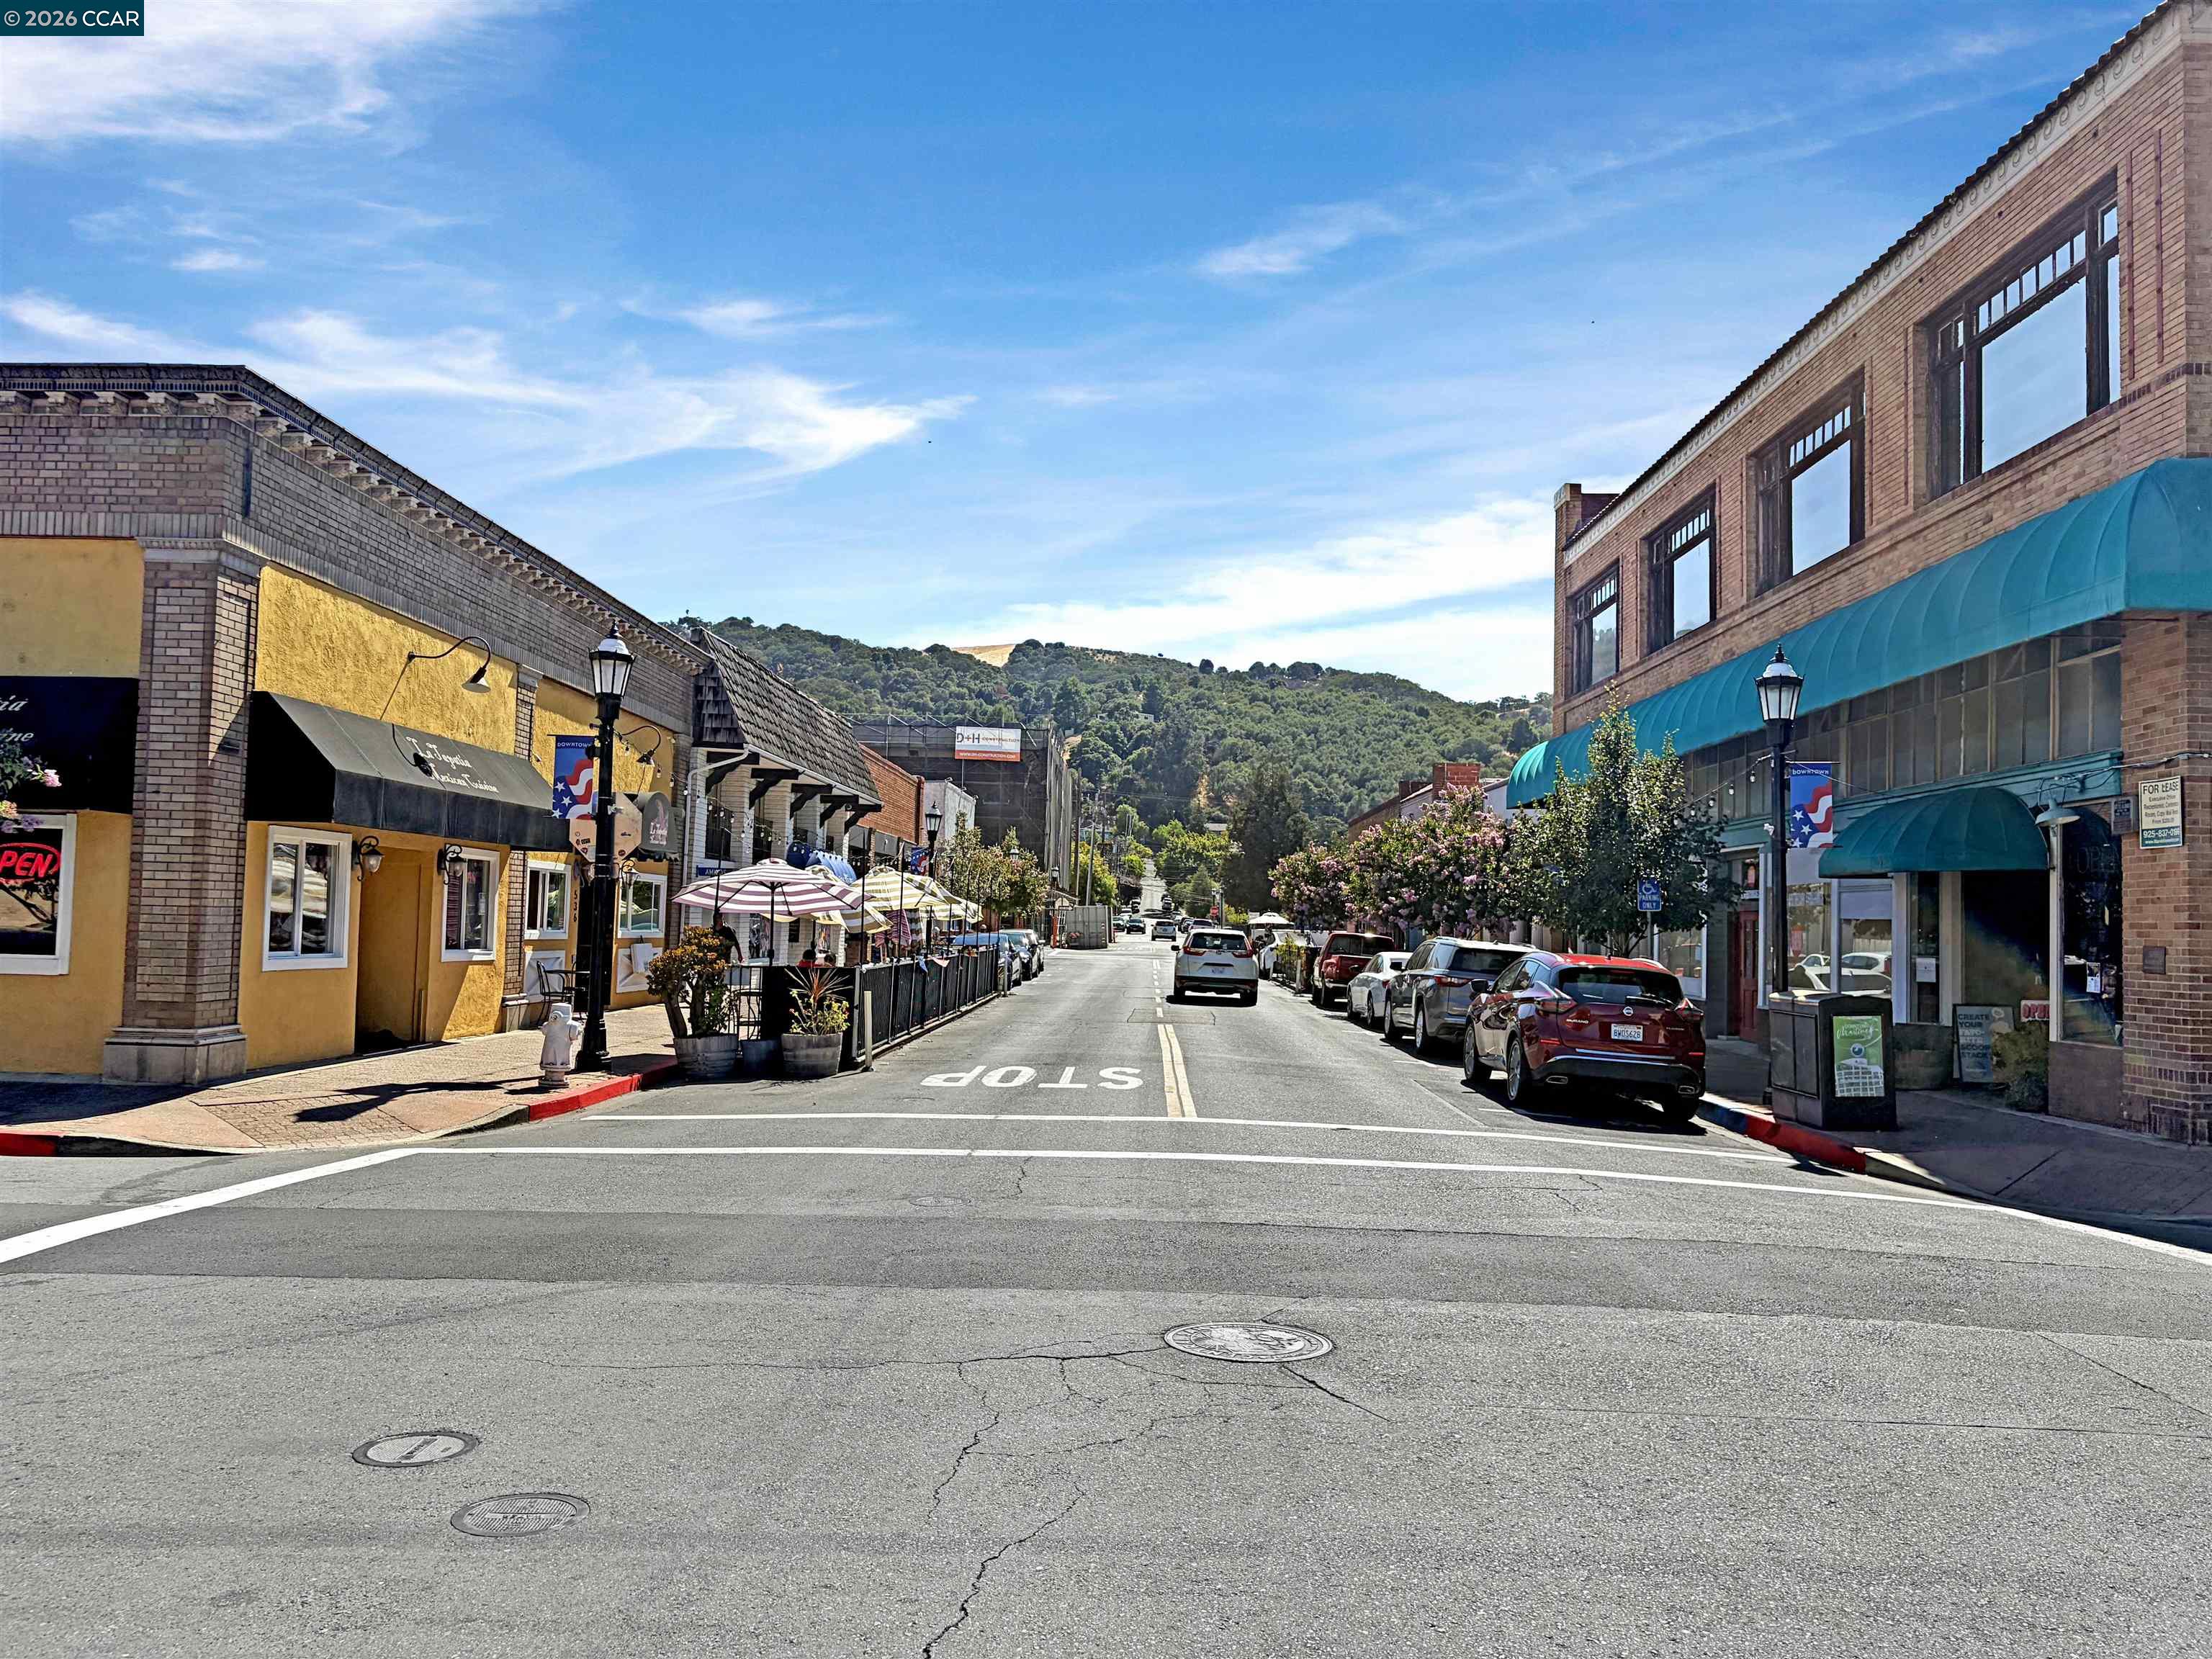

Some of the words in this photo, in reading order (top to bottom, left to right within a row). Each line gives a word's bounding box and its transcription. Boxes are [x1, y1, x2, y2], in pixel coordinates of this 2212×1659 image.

[2143, 784, 2159, 794] FOR
[2162, 781, 2178, 793] LEASE
[920, 1065, 1143, 1090] STOP
